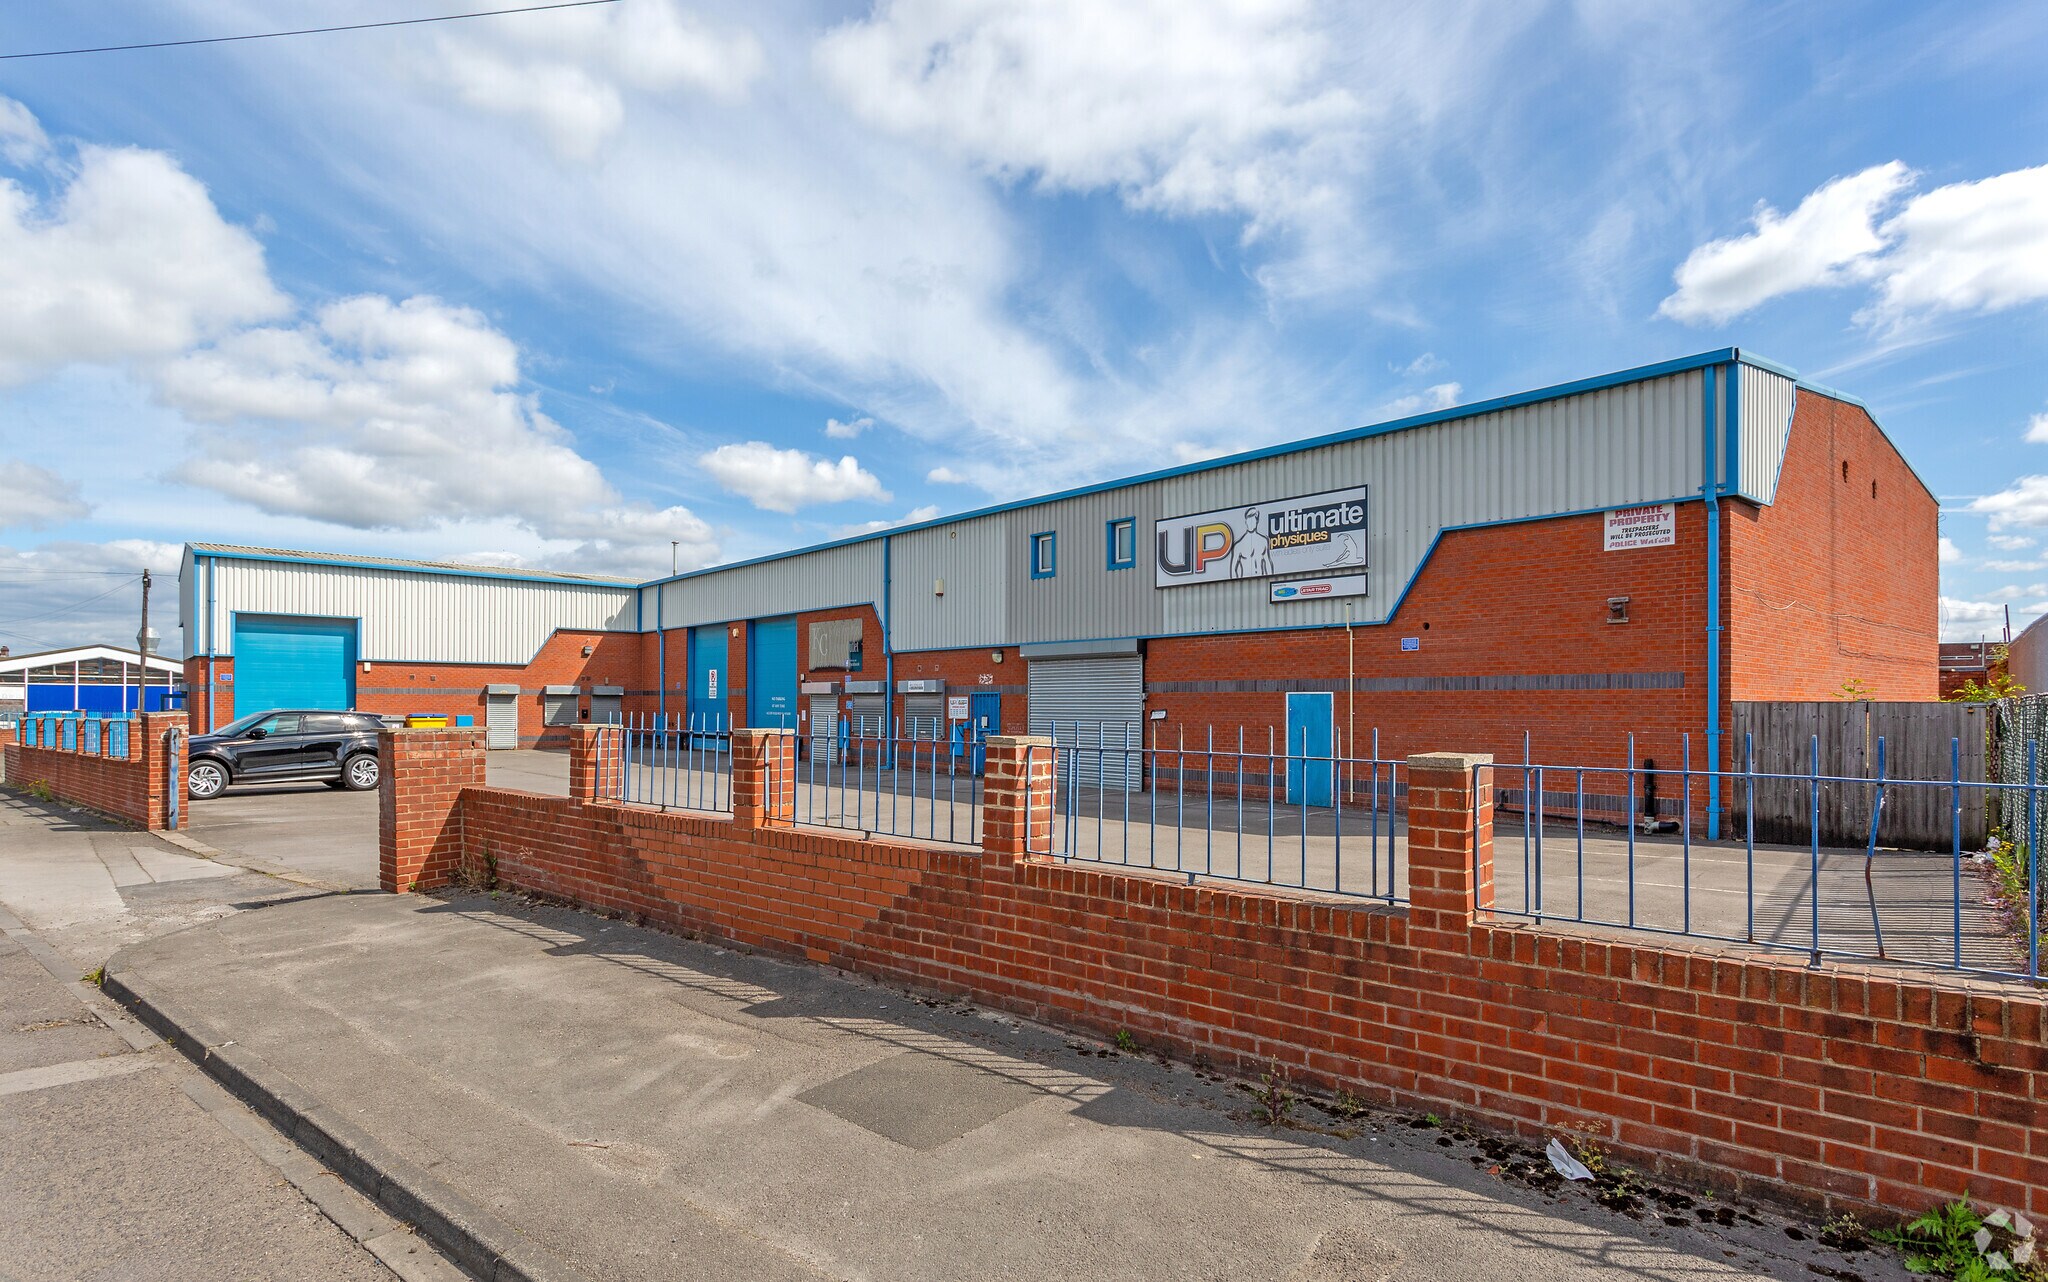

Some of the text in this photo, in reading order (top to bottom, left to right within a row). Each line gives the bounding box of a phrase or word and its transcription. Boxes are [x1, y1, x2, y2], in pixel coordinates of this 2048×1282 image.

[1615, 505, 1662, 518] PRIVATE
[1270, 503, 1364, 535] ultimate
[1610, 513, 1670, 527] PROPERTY
[1622, 524, 1659, 533] TRESPASSERS
[1634, 528, 1671, 538] PROSECUTED
[1270, 530, 1328, 550] physiques
[1609, 537, 1670, 548] POLICE WATCH
[1158, 521, 1235, 577] UP
